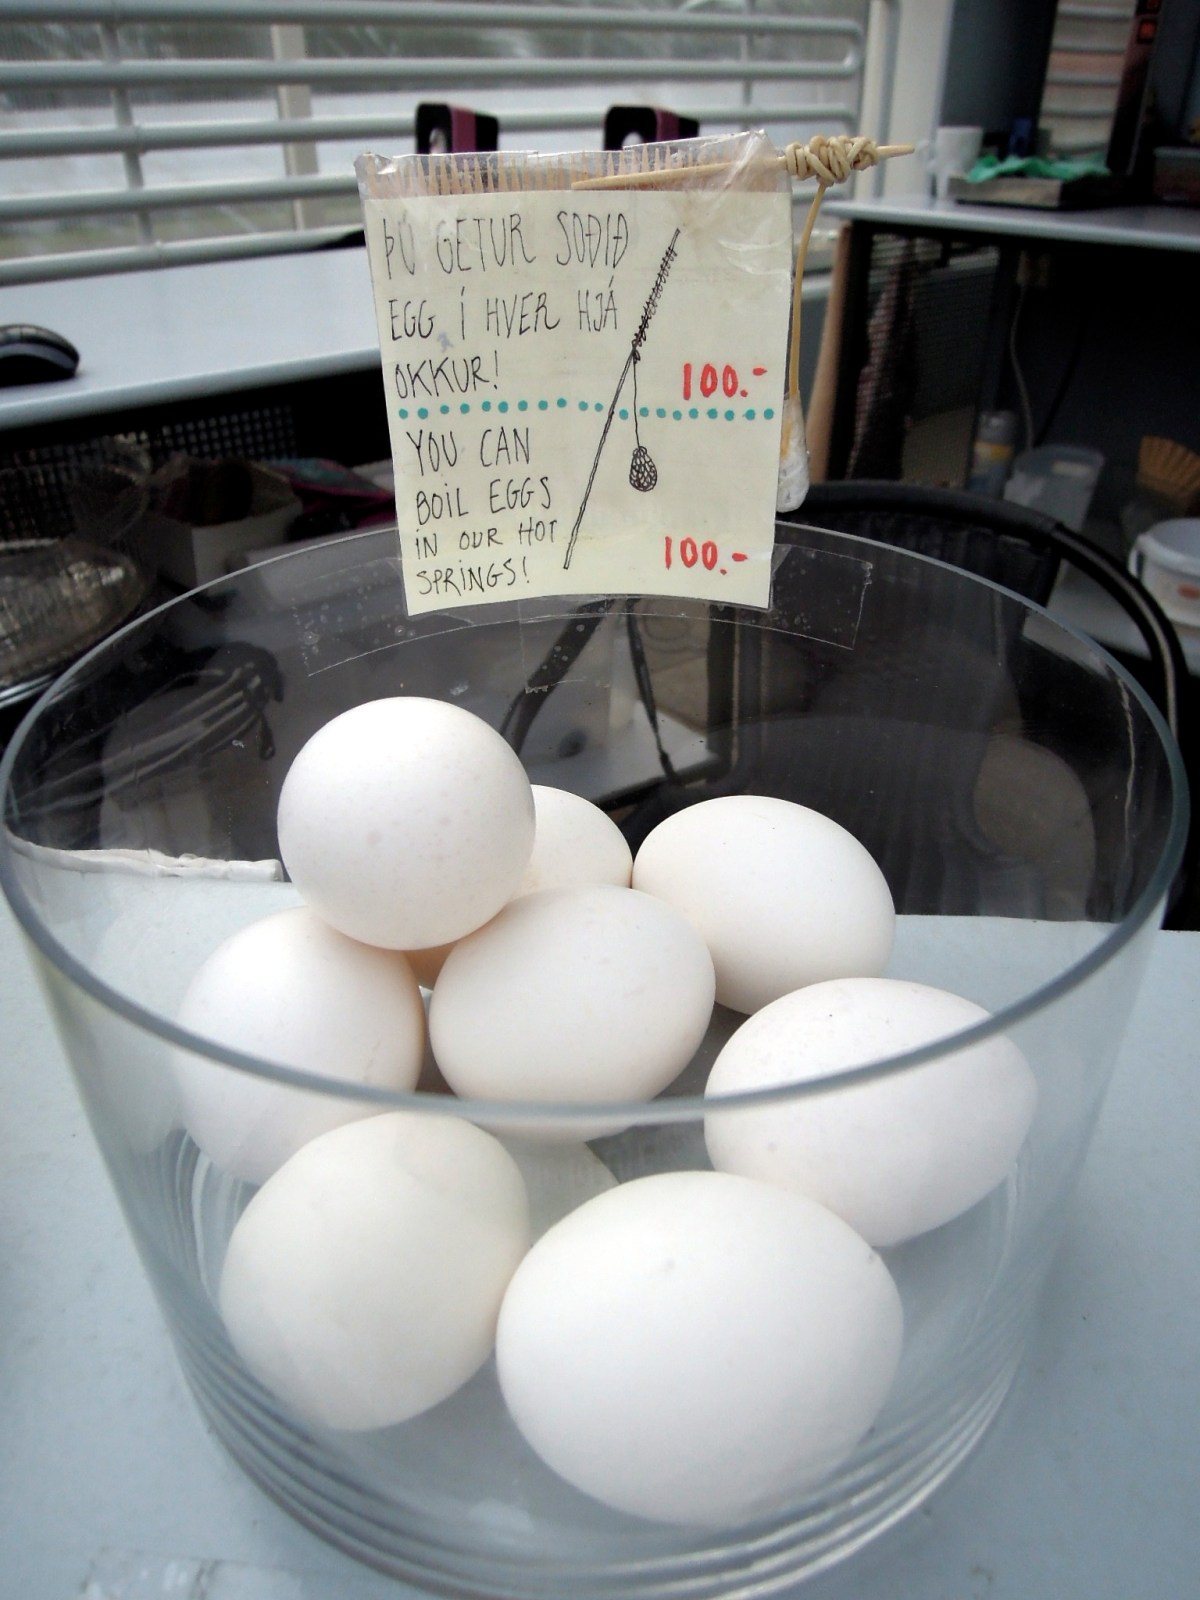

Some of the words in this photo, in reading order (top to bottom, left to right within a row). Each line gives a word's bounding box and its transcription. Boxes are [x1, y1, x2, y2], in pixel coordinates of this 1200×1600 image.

[436, 213, 537, 274] GETUR
[388, 299, 436, 341] EGG
[486, 292, 561, 339] HVER
[577, 275, 618, 332] HJÁ
[395, 350, 499, 399] OKKUR!
[406, 429, 458, 476] YOU
[480, 426, 530, 467] CAN
[489, 476, 551, 514] EGGS
[459, 528, 504, 550] OUR
[518, 517, 558, 546] HOT
